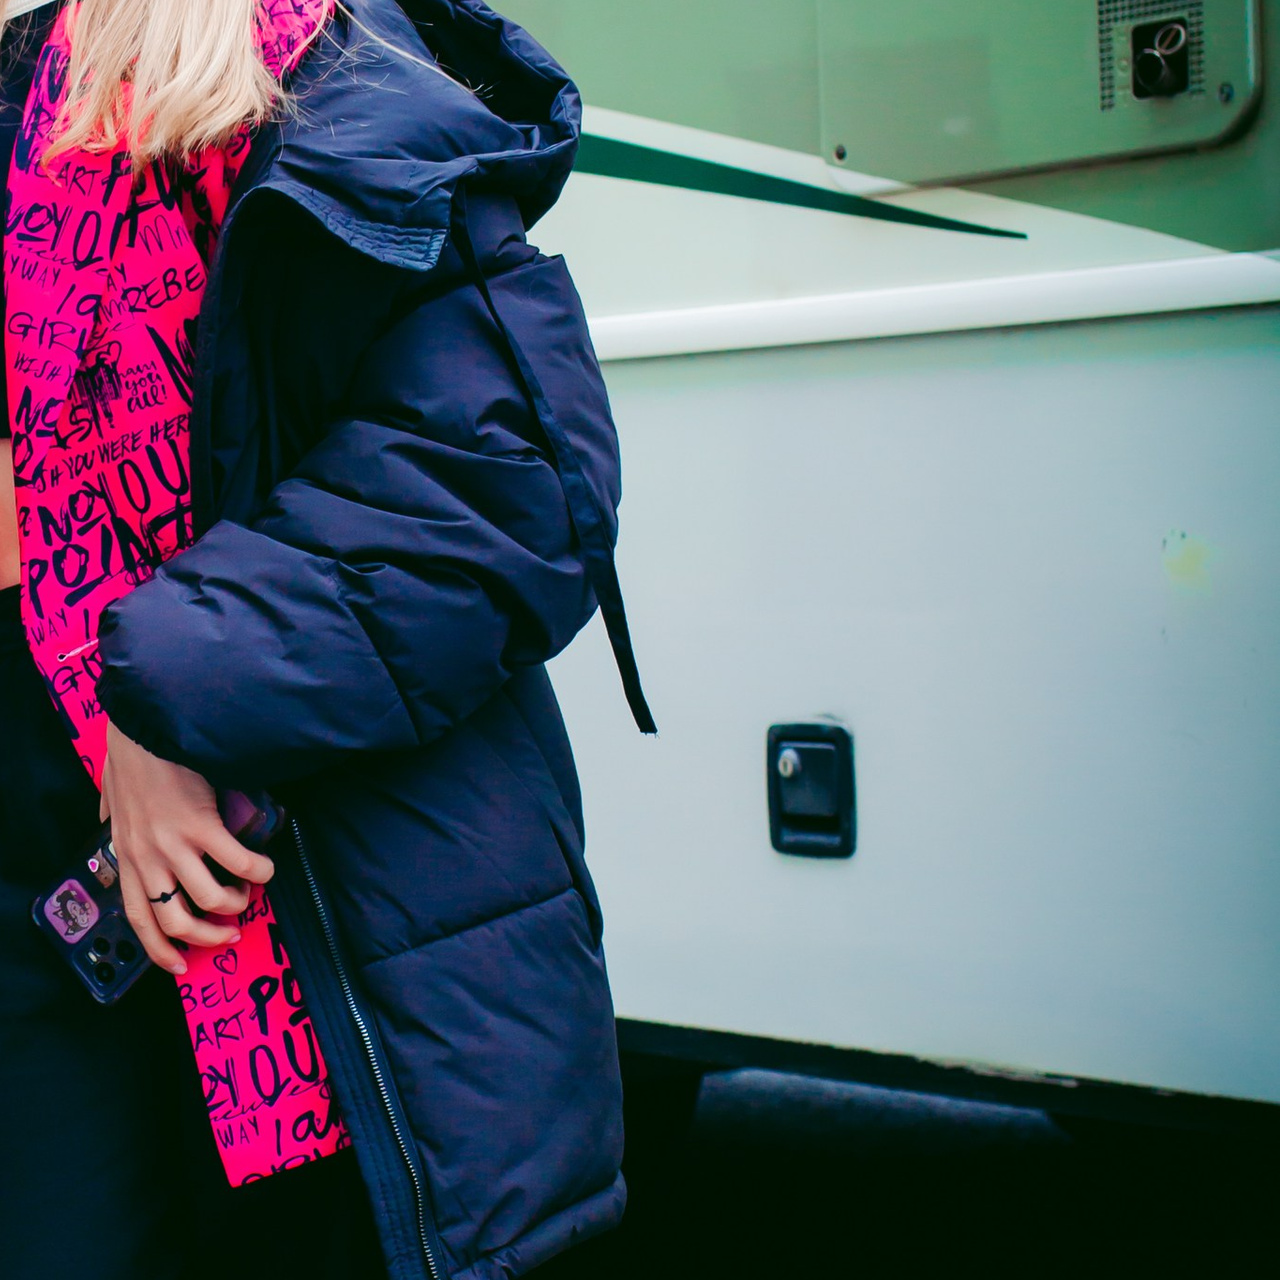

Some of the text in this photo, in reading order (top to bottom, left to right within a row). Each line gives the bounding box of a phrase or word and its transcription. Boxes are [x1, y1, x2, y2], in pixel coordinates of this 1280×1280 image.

[5, 251, 61, 288] YWAY
[122, 263, 205, 313] REBE
[14, 352, 61, 383] WISH
[125, 371, 163, 396] you
[36, 467, 64, 494] SH
[62, 449, 96, 480] YOU
[96, 430, 144, 464] WERE
[149, 411, 192, 444] HER
[37, 489, 96, 547] NO
[82, 438, 190, 520] YOU
[30, 607, 69, 646] WAY
[179, 976, 241, 1014] BEL
[194, 1008, 246, 1053] ART
[216, 1115, 260, 1150] WAY
